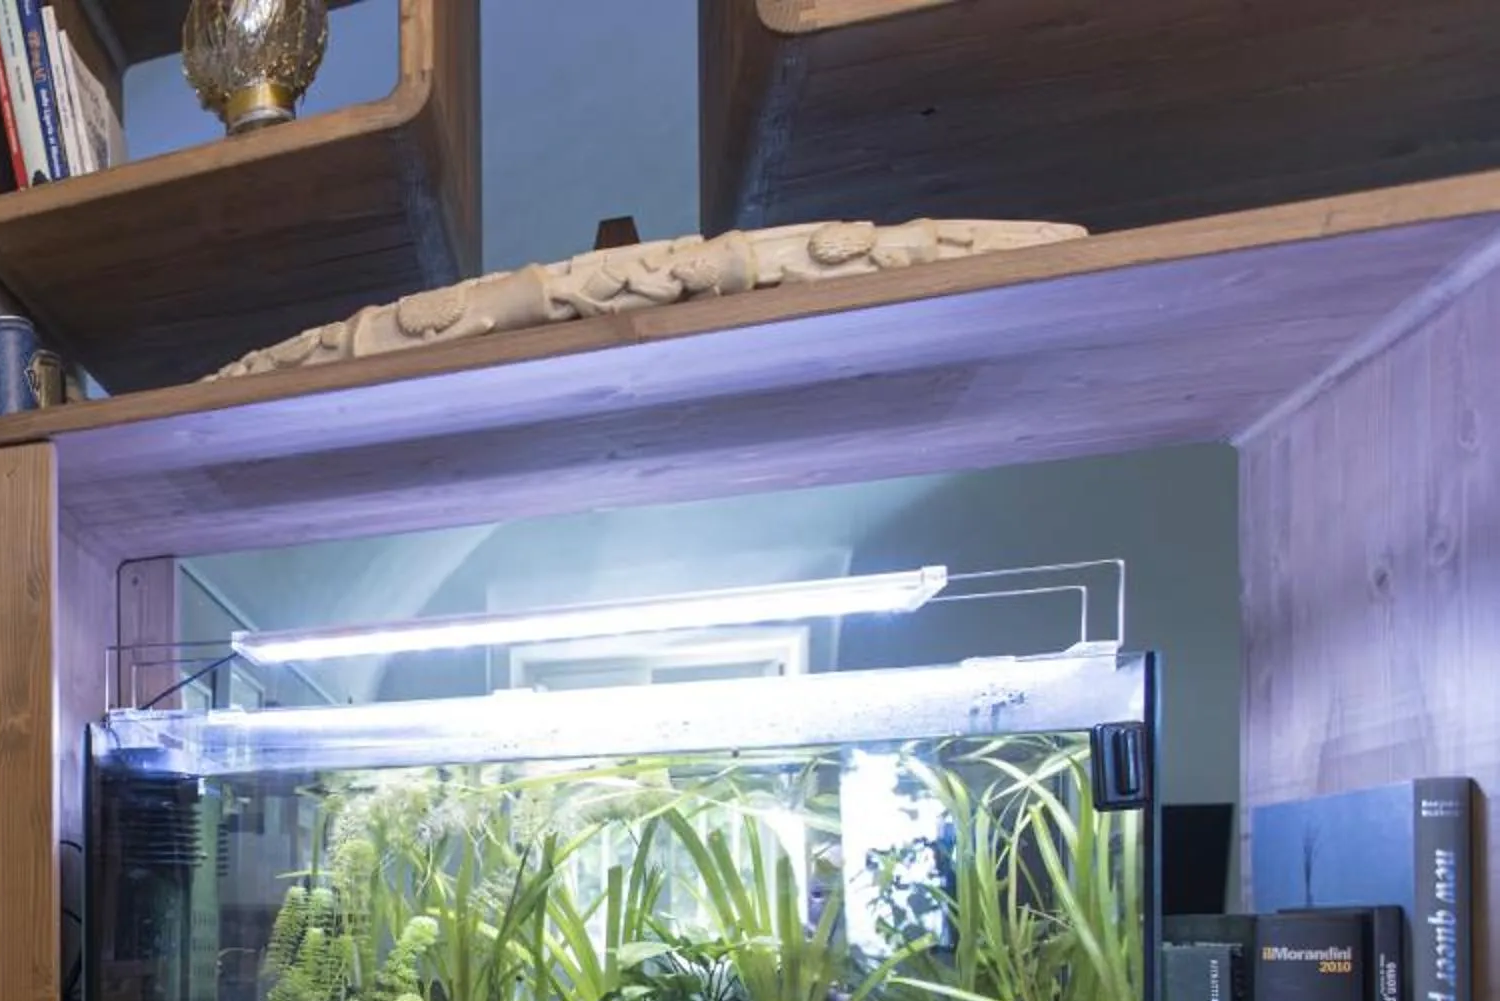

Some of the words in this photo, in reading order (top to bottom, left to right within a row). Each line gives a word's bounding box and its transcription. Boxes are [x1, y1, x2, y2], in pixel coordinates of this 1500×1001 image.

[1435, 849, 1458, 901] new
[1319, 961, 1351, 973] 2010
[1428, 906, 1458, 980] queer
